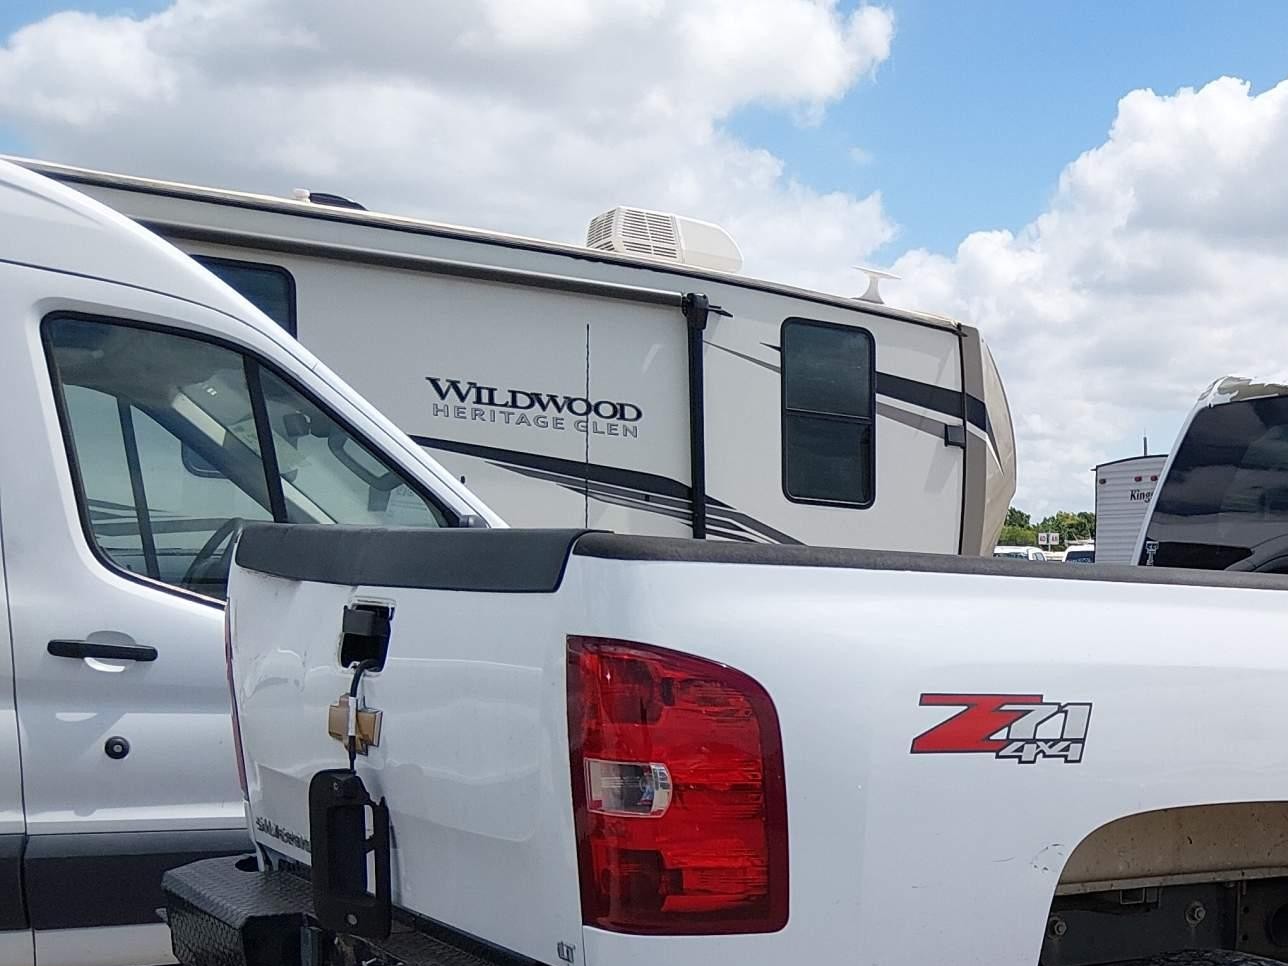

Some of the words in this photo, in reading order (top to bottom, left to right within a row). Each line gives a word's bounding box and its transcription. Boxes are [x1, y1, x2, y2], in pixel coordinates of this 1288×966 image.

[425, 376, 643, 422] WILDWOOD
[432, 403, 566, 431] HERITAGE
[573, 419, 638, 438] GLEN
[910, 693, 1093, 753] Z71
